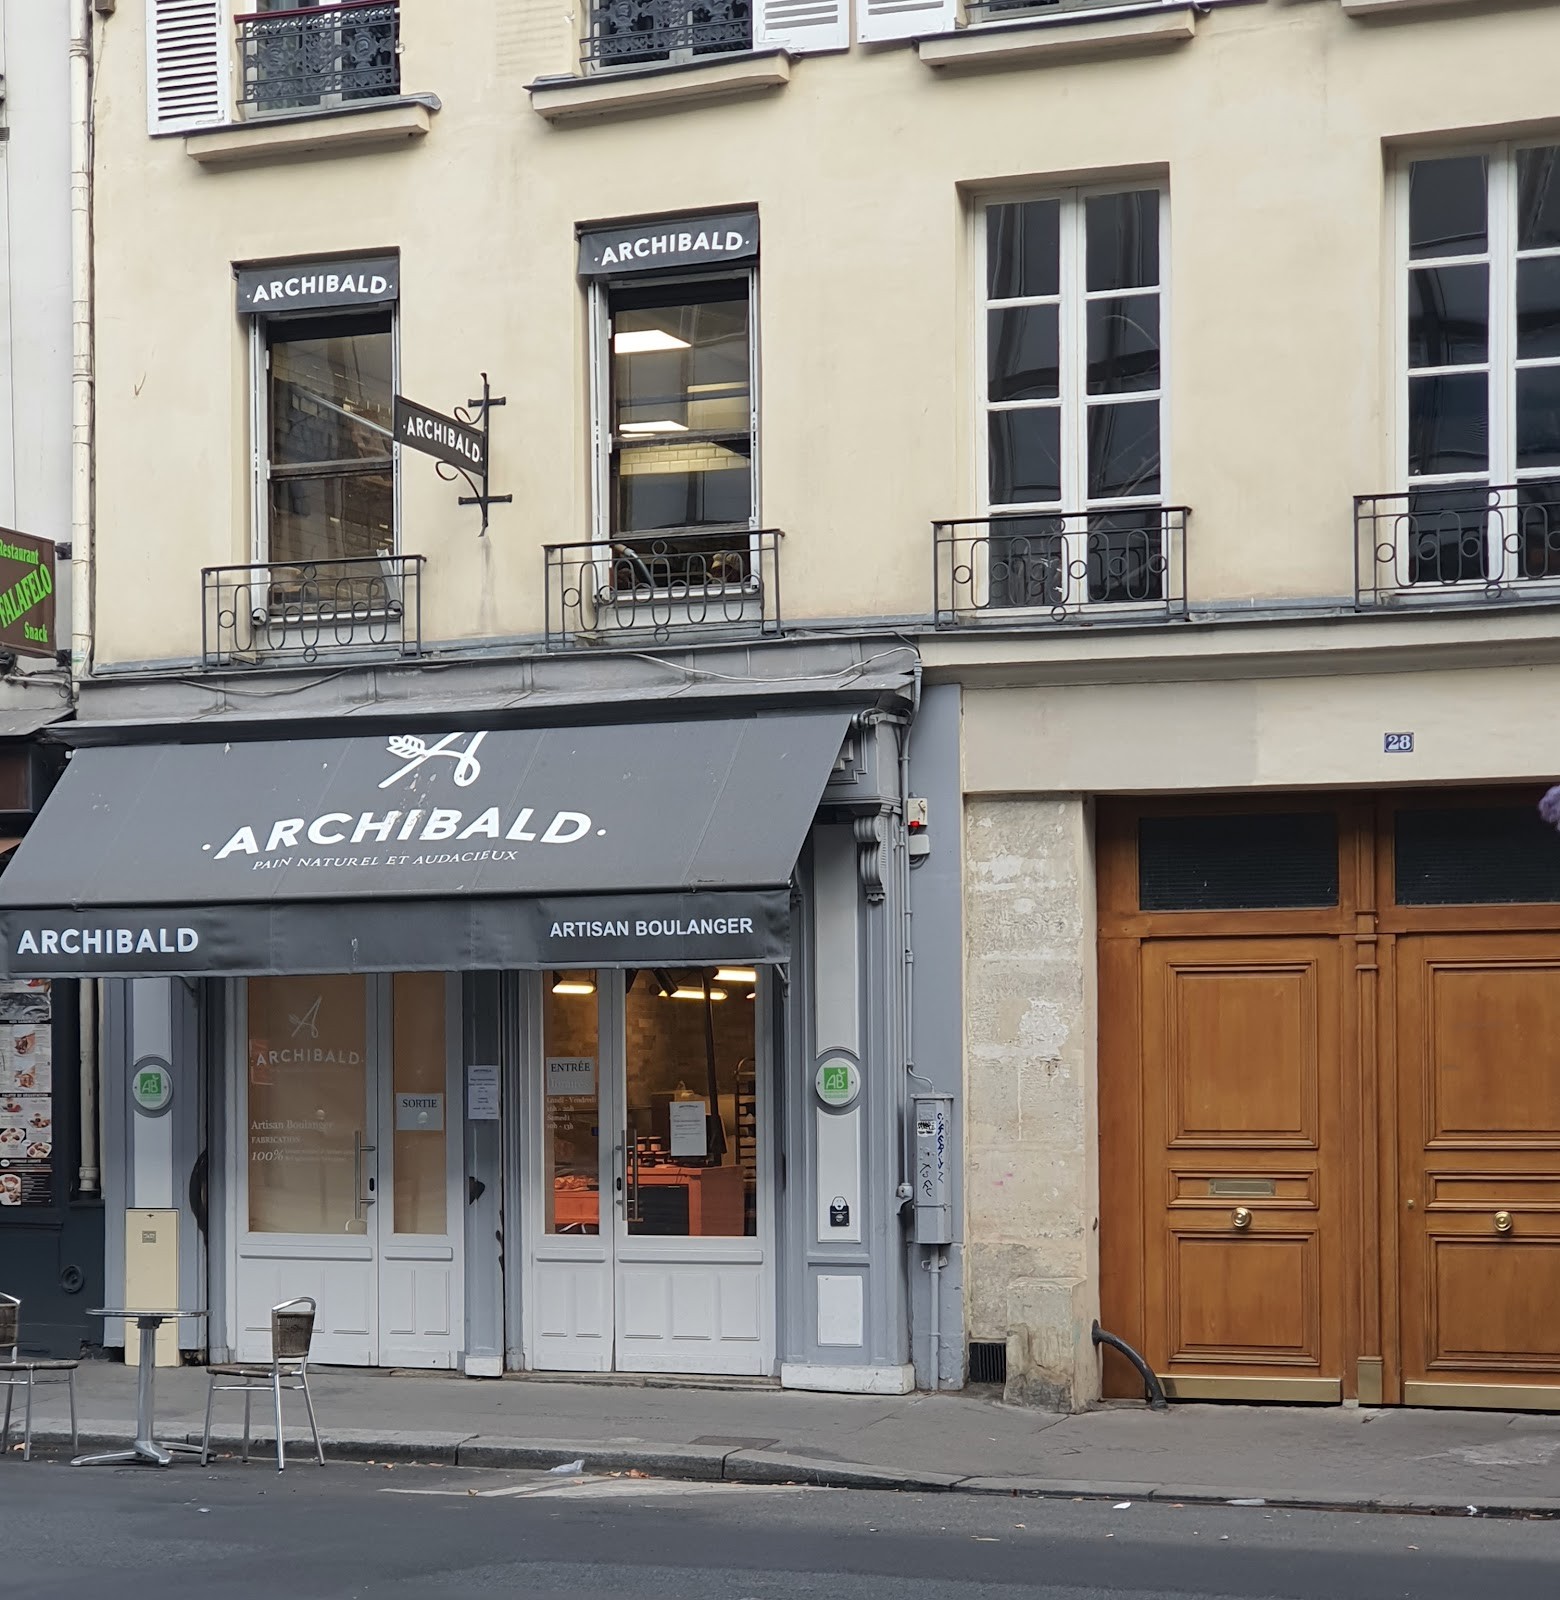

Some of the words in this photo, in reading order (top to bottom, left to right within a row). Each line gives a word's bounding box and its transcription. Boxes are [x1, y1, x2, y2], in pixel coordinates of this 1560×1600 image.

[25, 621, 48, 643] Snack
[1387, 734, 1411, 750] 28
[252, 857, 294, 870] PAIN
[297, 856, 379, 867] NATUREL
[385, 855, 410, 865] ET
[412, 850, 518, 865] AUDACIEUX
[549, 920, 629, 938] ARTISAN
[635, 917, 754, 937] BOULANGER
[17, 927, 200, 955] ARCHIBALD
[550, 1060, 591, 1073] ENTRÉE
[402, 1099, 437, 1108] SORTIE
[251, 1120, 284, 1130] Artisan
[251, 1136, 302, 1145] FABRICATION
[251, 1149, 284, 1161] 100%
